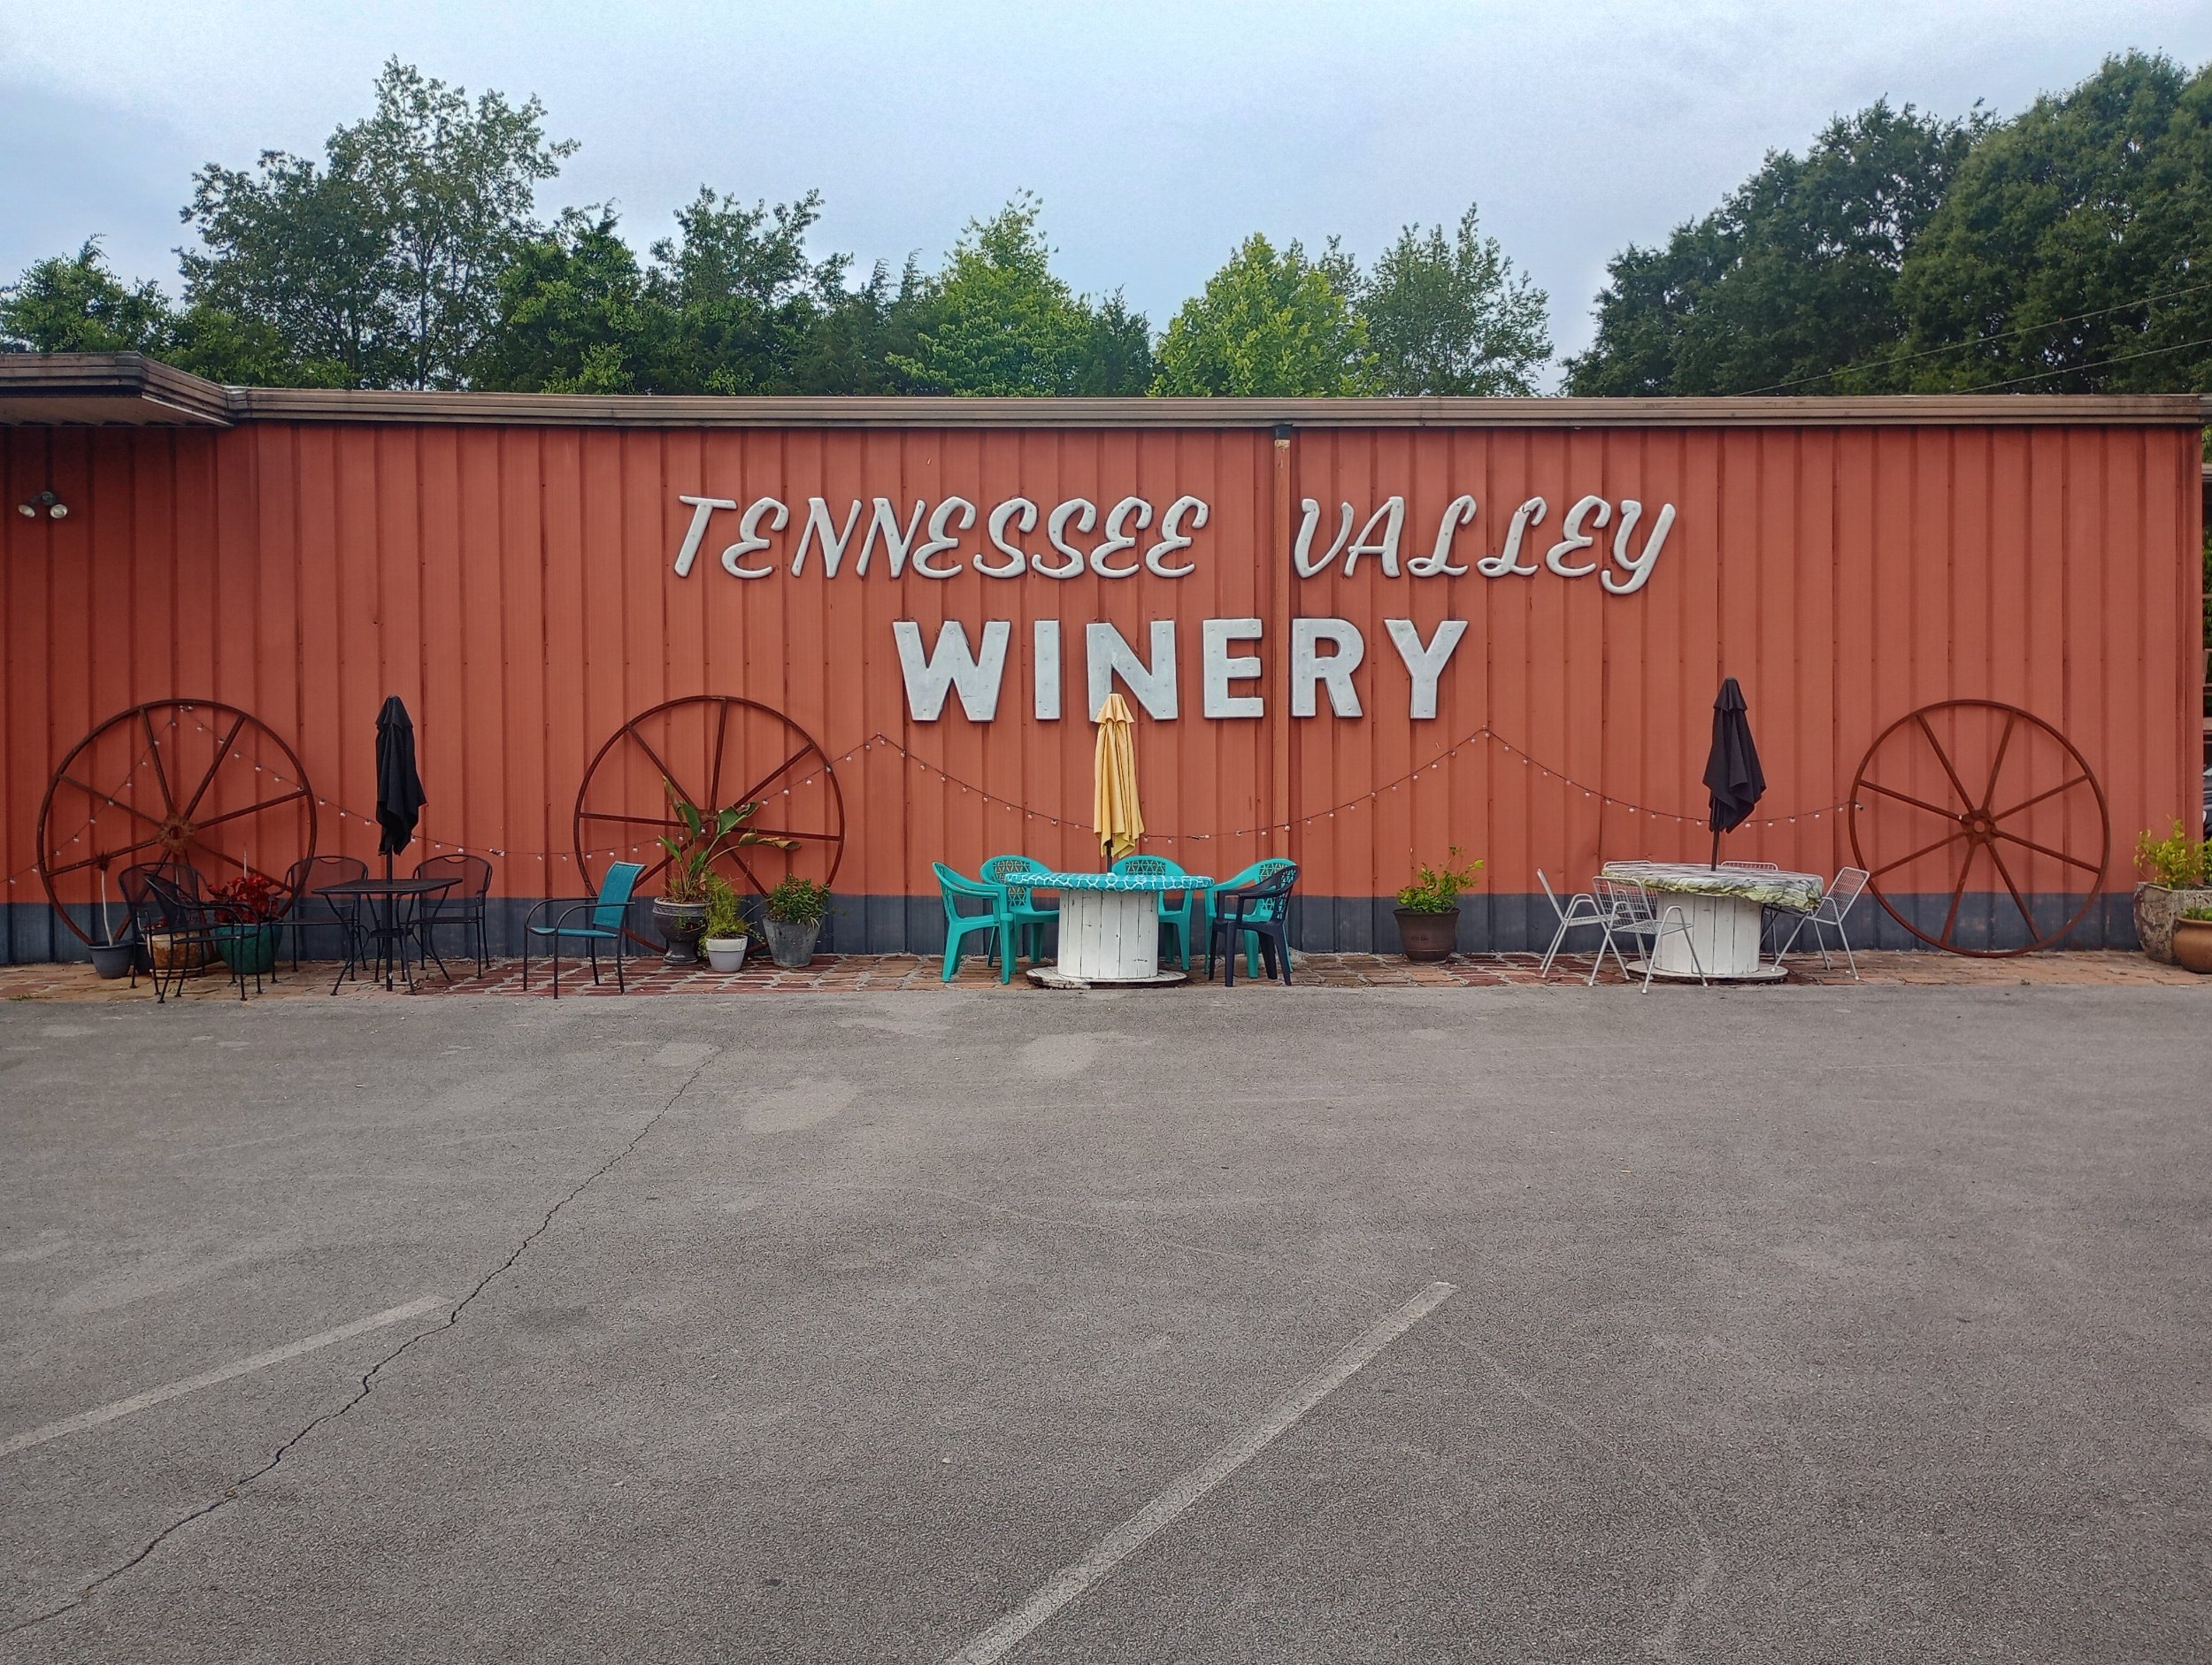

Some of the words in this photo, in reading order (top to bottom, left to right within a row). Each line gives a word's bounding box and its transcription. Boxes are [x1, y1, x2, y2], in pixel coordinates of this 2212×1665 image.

[673, 494, 1210, 579] TENNESSEE
[1294, 493, 1678, 595] VALLEY
[891, 617, 1470, 724] WINERY
